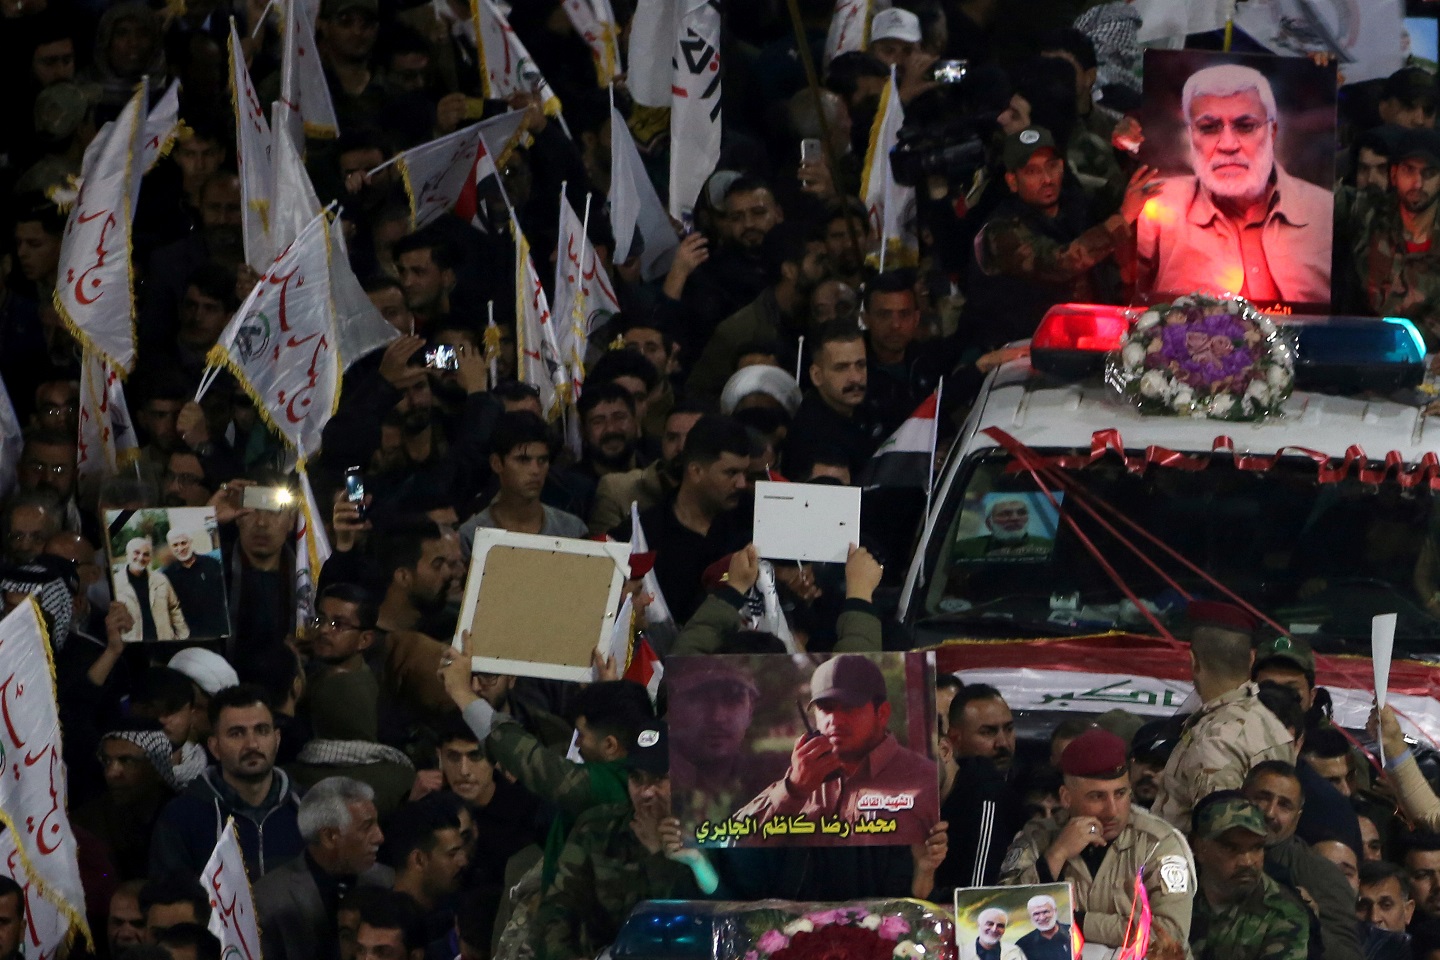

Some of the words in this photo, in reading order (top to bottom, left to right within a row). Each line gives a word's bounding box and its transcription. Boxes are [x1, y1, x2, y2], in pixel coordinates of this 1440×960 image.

[885, 793, 913, 809] الشهيد
[695, 816, 757, 843] الجابري
[763, 817, 816, 840] كاظم
[821, 815, 851, 839] رضا
[855, 816, 898, 834] محمد
